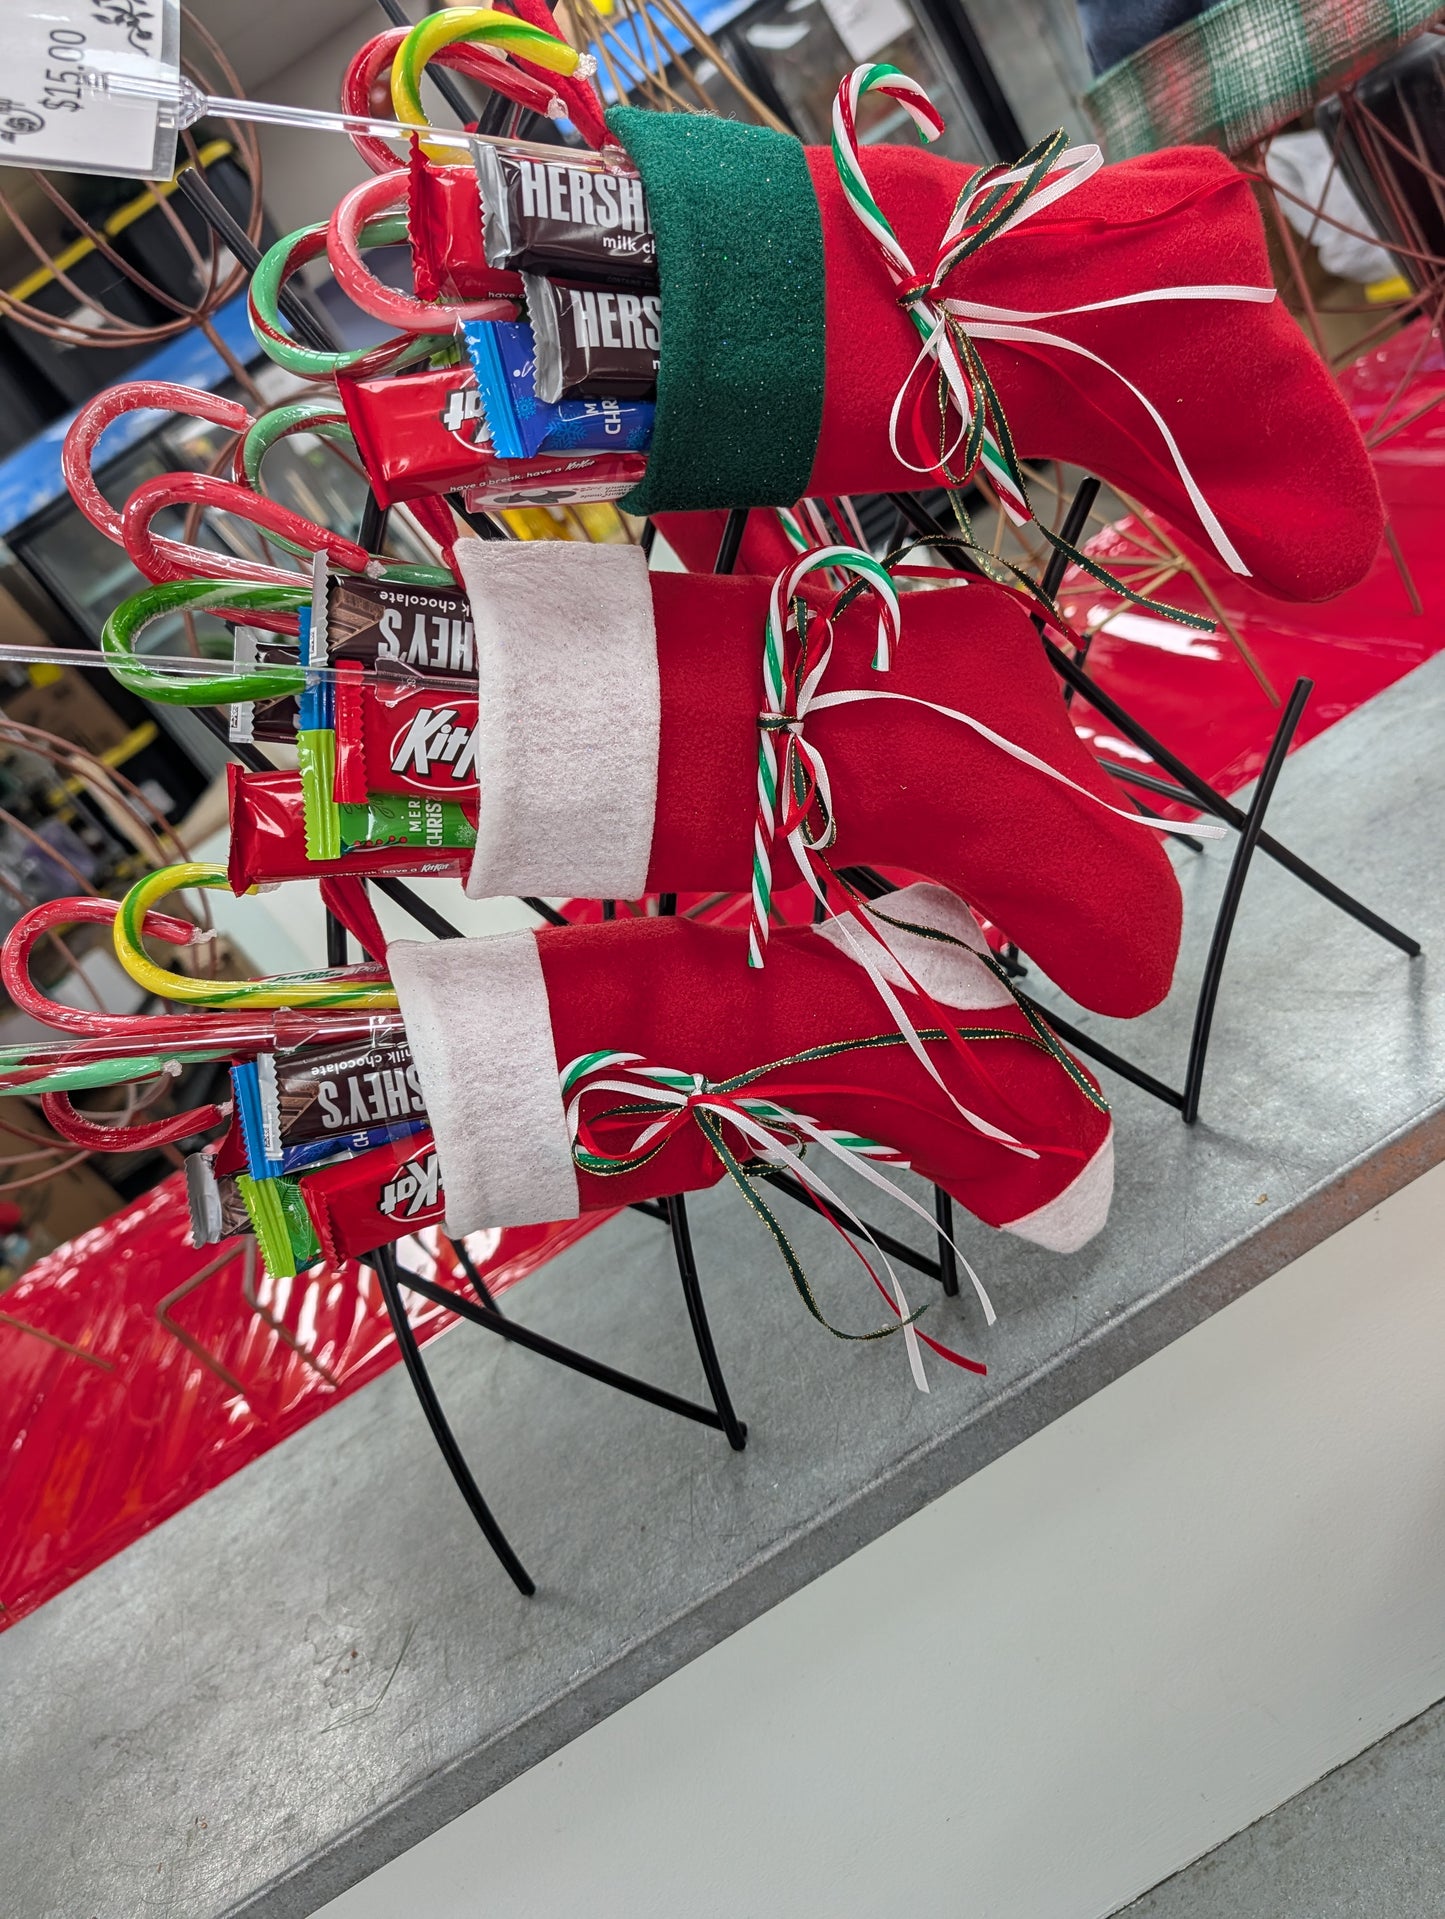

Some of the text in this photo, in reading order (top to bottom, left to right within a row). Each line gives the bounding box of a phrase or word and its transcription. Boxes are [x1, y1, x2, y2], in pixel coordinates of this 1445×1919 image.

[38, 29, 87, 112] $15.00
[520, 160, 653, 235] HERSH
[603, 234, 637, 253] milk
[488, 290, 516, 299] have
[450, 482, 476, 493] have
[488, 475, 525, 487] break,
[526, 468, 552, 478] have
[379, 591, 457, 614] chocolate
[377, 608, 473, 672] HEY'S
[408, 796, 422, 832] MER
[311, 1054, 383, 1077] chocolate
